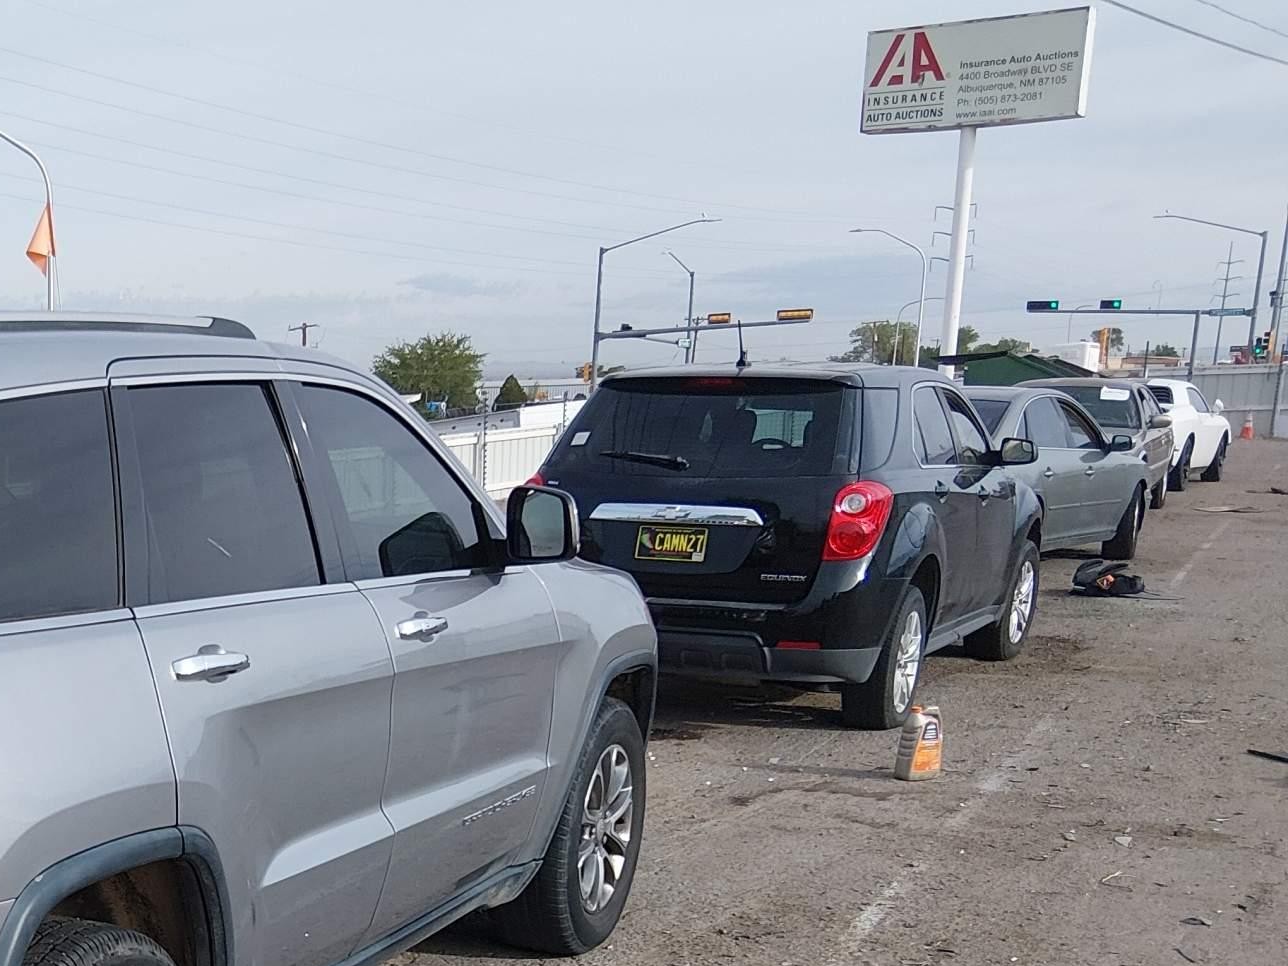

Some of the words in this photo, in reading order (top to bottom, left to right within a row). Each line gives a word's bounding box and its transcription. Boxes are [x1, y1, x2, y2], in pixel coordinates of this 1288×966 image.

[959, 59, 1007, 70] Insurance
[1008, 55, 1032, 65] Auto
[1033, 50, 1079, 62] Auctions
[958, 71, 981, 81] 4400
[983, 68, 1028, 80] Broadway
[1030, 63, 1057, 75] BLVD
[1059, 61, 1074, 72] SE
[1019, 78, 1036, 88] NM
[1038, 74, 1068, 87] 87105
[867, 90, 945, 108] INSURANCE
[974, 95, 998, 107] (505)
[1000, 91, 1043, 104] 873-2081
[865, 112, 892, 124] AUTO
[894, 106, 945, 121] AUCTIONS
[654, 531, 705, 554] CAMN27
